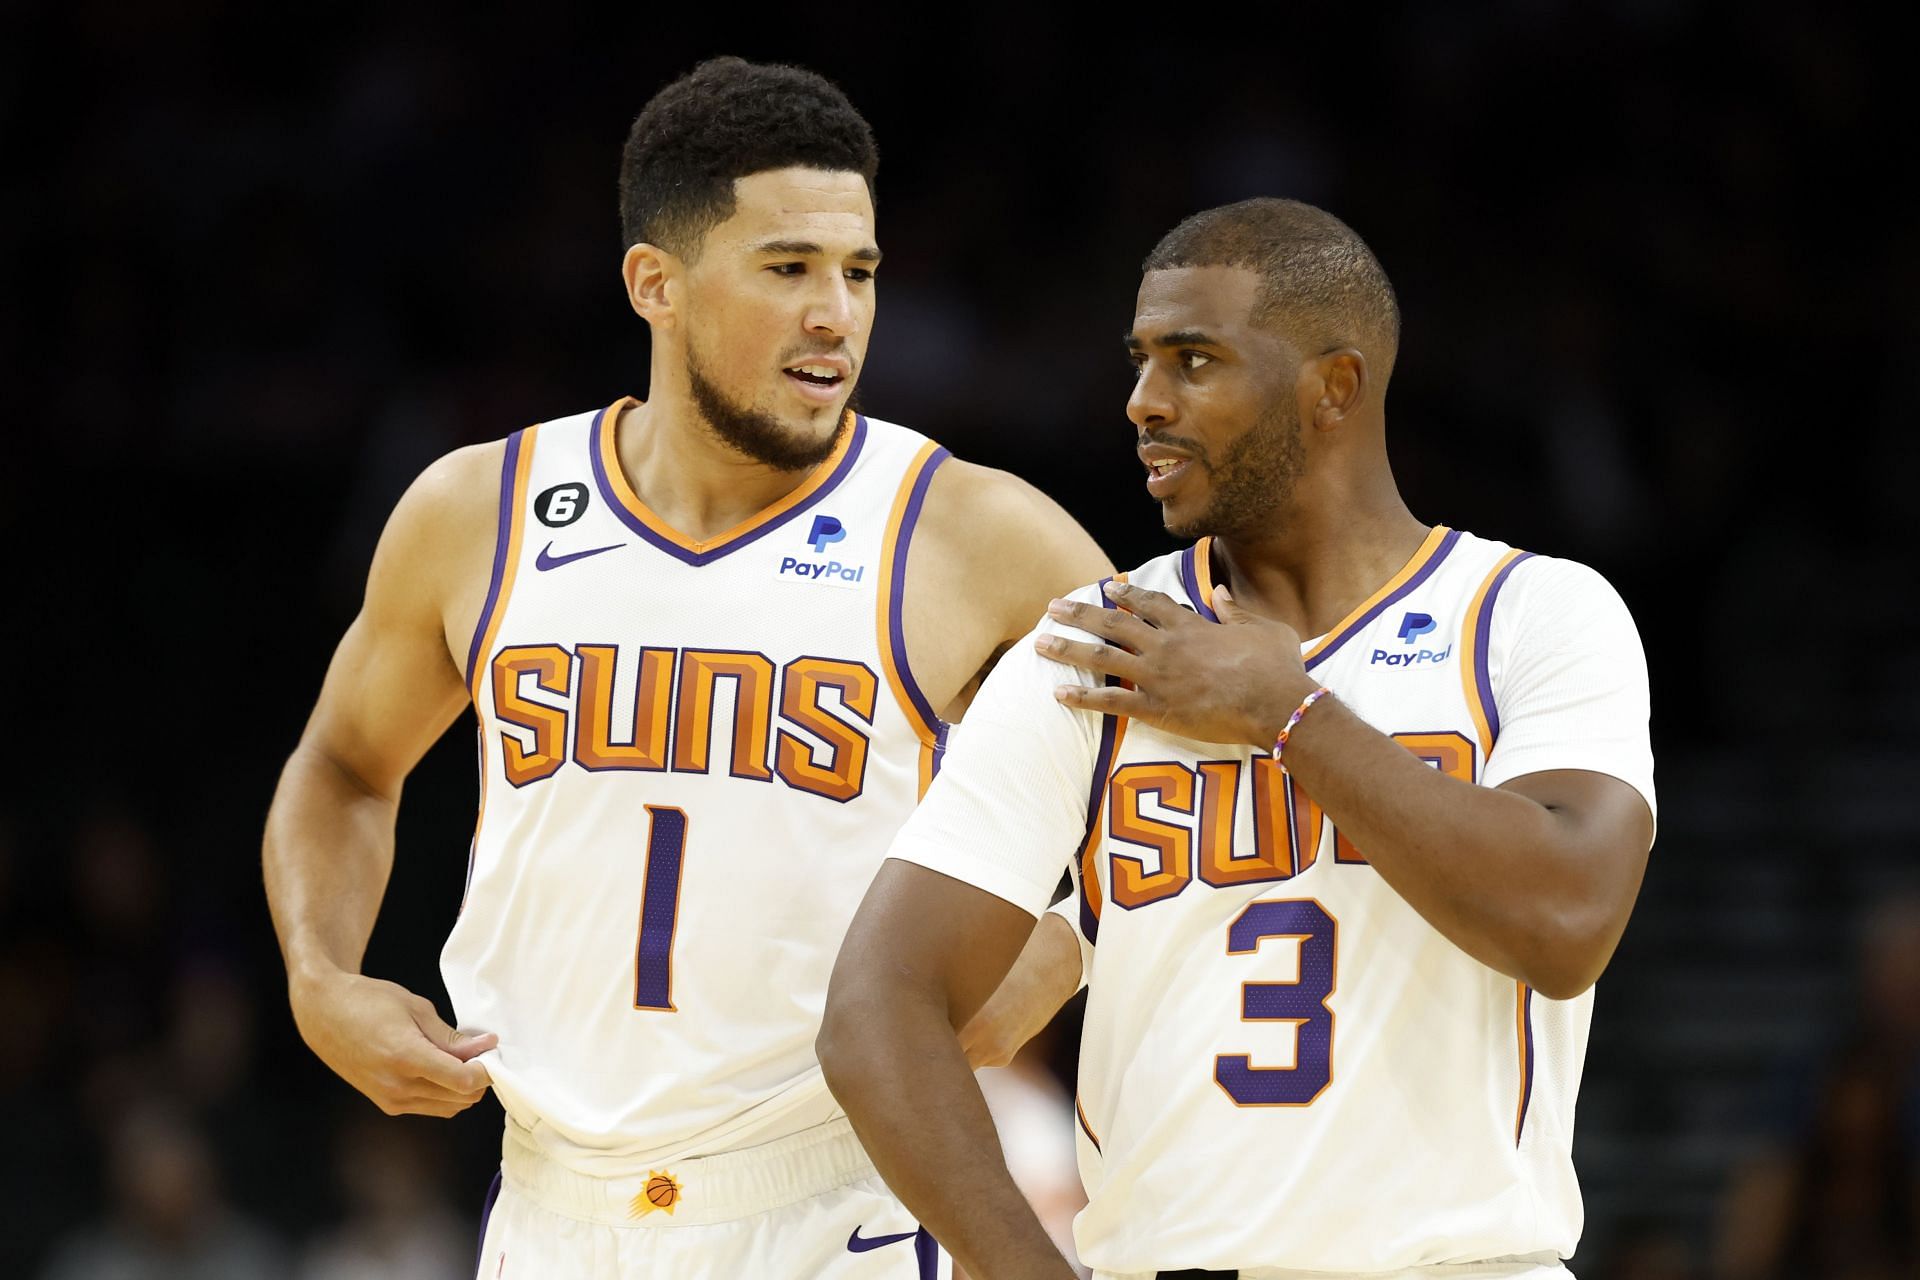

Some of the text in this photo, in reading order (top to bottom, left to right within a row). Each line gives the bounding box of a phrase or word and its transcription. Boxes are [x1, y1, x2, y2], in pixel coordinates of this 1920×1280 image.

[545, 488, 580, 522] 6
[780, 556, 864, 582] PayPal
[491, 643, 879, 804] SUNS
[1370, 643, 1452, 667] PayPal
[1108, 731, 1476, 912] SU
[633, 804, 689, 1013] 1
[1213, 897, 1338, 1107] 3
